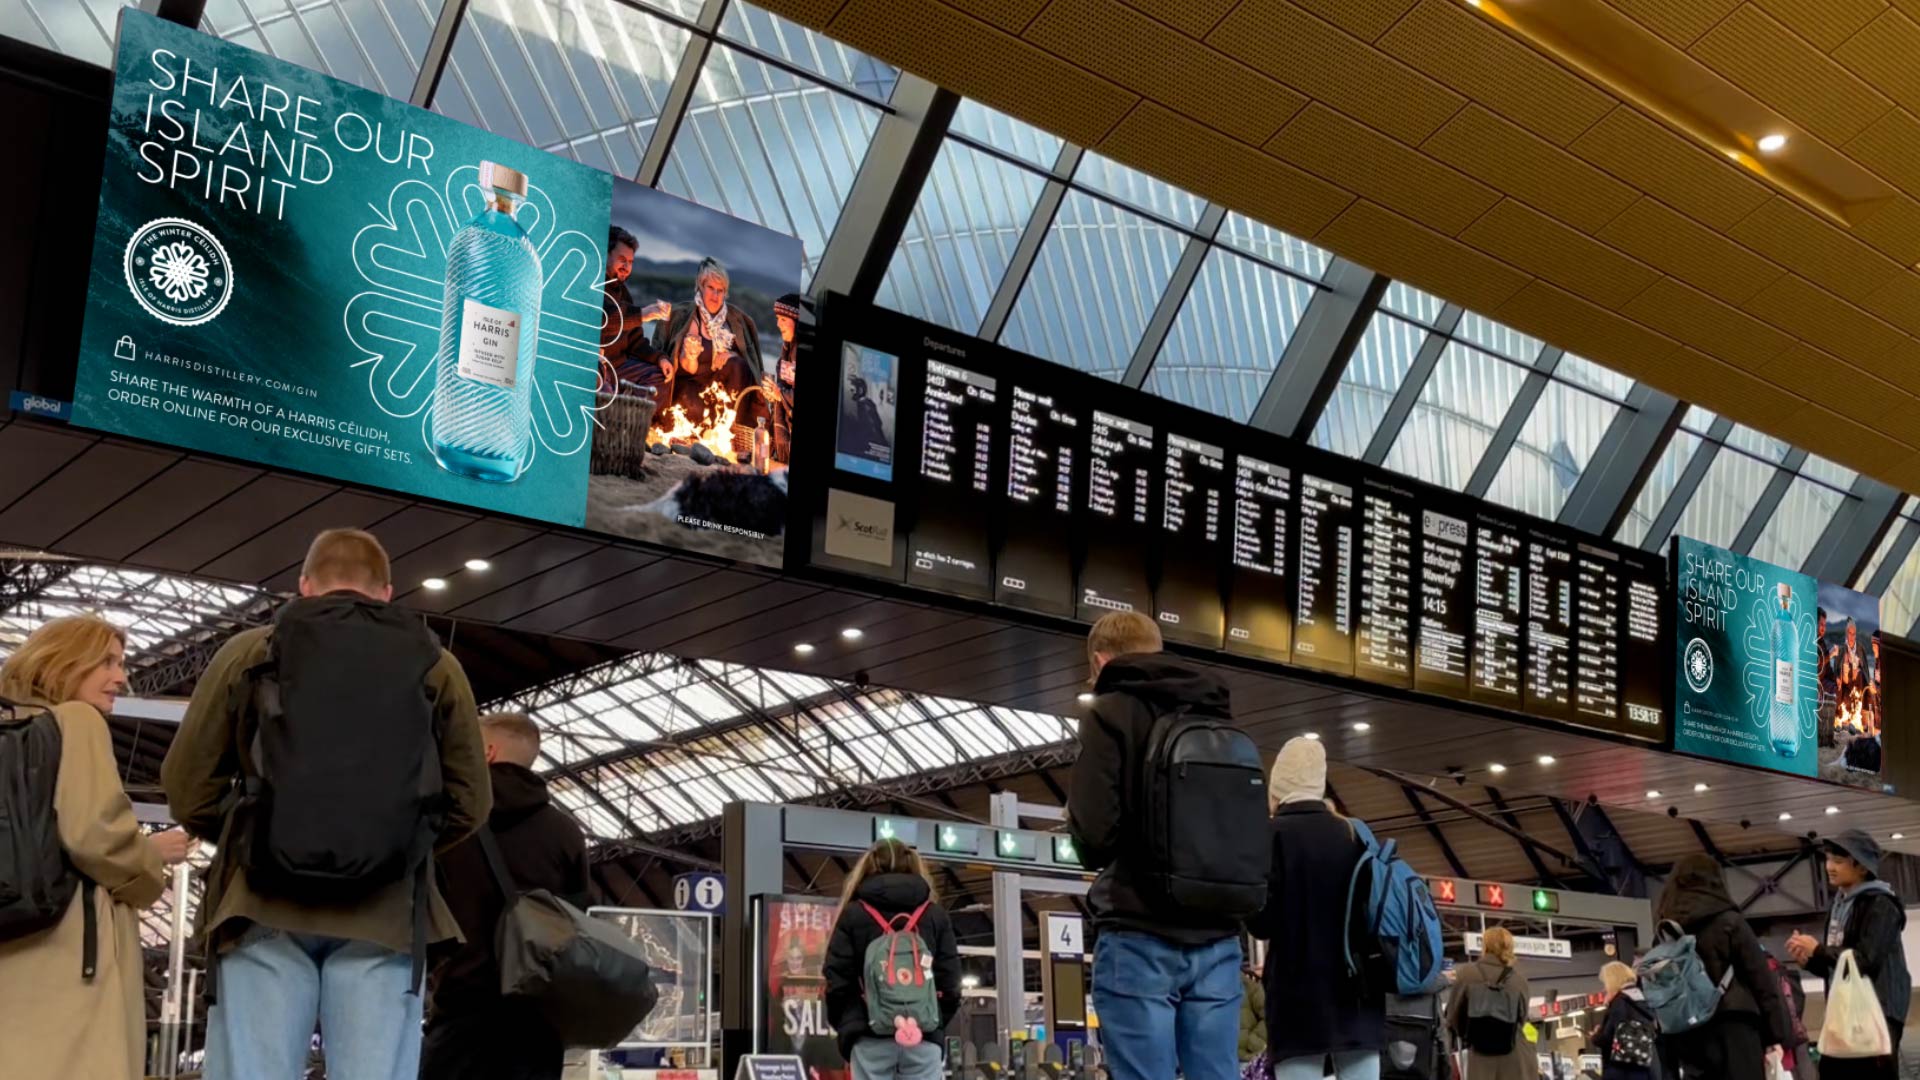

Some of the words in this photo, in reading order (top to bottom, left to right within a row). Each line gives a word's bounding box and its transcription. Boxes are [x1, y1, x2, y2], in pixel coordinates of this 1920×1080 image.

[149, 49, 321, 139] SHARE
[335, 112, 434, 175] OUR
[145, 94, 333, 184] ISLAND
[137, 141, 296, 220] SPIRIT
[143, 232, 158, 246] THE
[158, 228, 192, 238] WINTER
[139, 278, 148, 292] ISLE
[148, 292, 156, 301] OF
[157, 300, 182, 313] HARRIS
[184, 296, 216, 314] DISTILLERY
[474, 321, 509, 338] HARRIS
[483, 338, 498, 347] GIN
[923, 336, 966, 358] Departures
[145, 351, 318, 398] HARRISDISTILLERY.COM/GIN
[928, 360, 959, 379] Platform
[23, 395, 61, 412] global
[110, 370, 158, 391] SHARE
[162, 381, 188, 398] THE
[192, 388, 252, 412] WARMTH
[254, 402, 274, 416] OF
[276, 408, 286, 418] A
[288, 411, 336, 430] HARRIS
[967, 385, 978, 397] On
[979, 389, 996, 402] time
[1014, 386, 1036, 401] Please
[108, 388, 159, 409] ORDER
[162, 400, 216, 422] ONLINE
[220, 412, 248, 428] FOR
[251, 420, 281, 436] OUR
[284, 426, 351, 450] EXCLUSIVE
[354, 442, 381, 457] GIFT
[384, 448, 413, 464] SETS.
[1050, 410, 1060, 421] On
[1062, 414, 1076, 426] time
[1093, 410, 1114, 426] Please
[1127, 433, 1136, 445] On
[1139, 437, 1153, 449] time
[1199, 455, 1208, 466] On
[1210, 458, 1224, 470] time
[1267, 475, 1276, 486] On
[1277, 478, 1290, 490] time
[678, 515, 700, 525] PLEASE
[703, 520, 722, 530] DRINK
[724, 524, 764, 540] RESPONSIBLY
[1423, 552, 1461, 573] Edinburgh
[1423, 567, 1456, 589] Waverley
[1686, 553, 1732, 587] SHARE
[1736, 568, 1764, 596] OUR
[1686, 576, 1738, 610] ISLAND
[1423, 596, 1446, 614] 14:15
[1685, 601, 1728, 632] SPIRIT
[1060, 924, 1072, 946] 4
